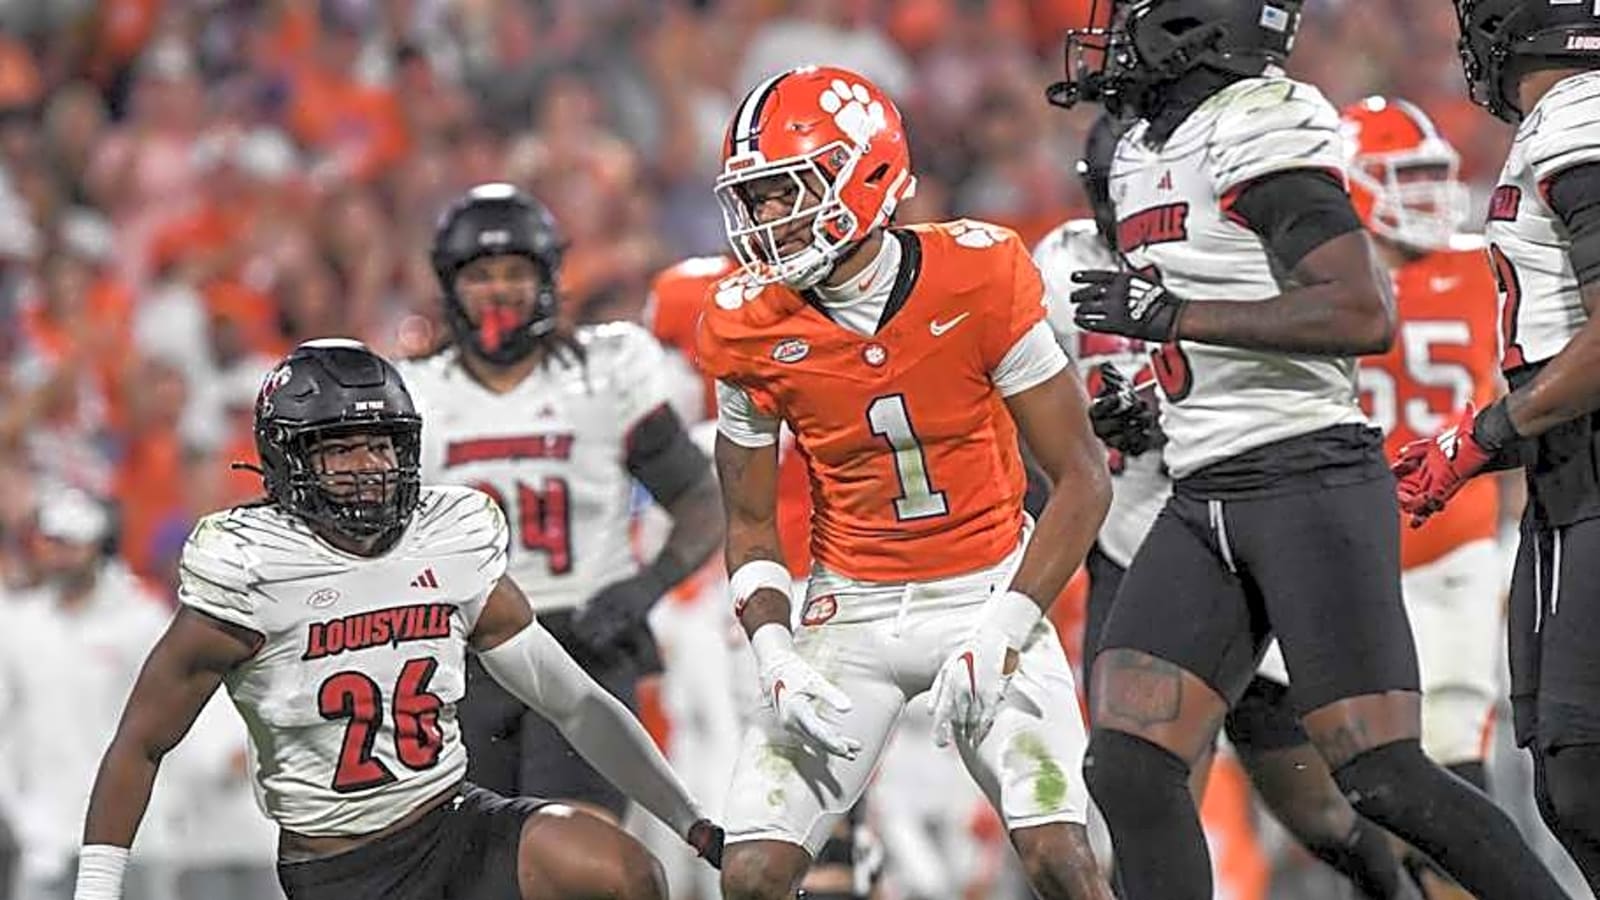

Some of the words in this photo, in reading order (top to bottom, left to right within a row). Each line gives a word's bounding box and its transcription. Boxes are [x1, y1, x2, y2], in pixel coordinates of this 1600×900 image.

[866, 392, 950, 523] 1
[302, 603, 458, 661] LOUISVILLE
[317, 656, 446, 794] 26
